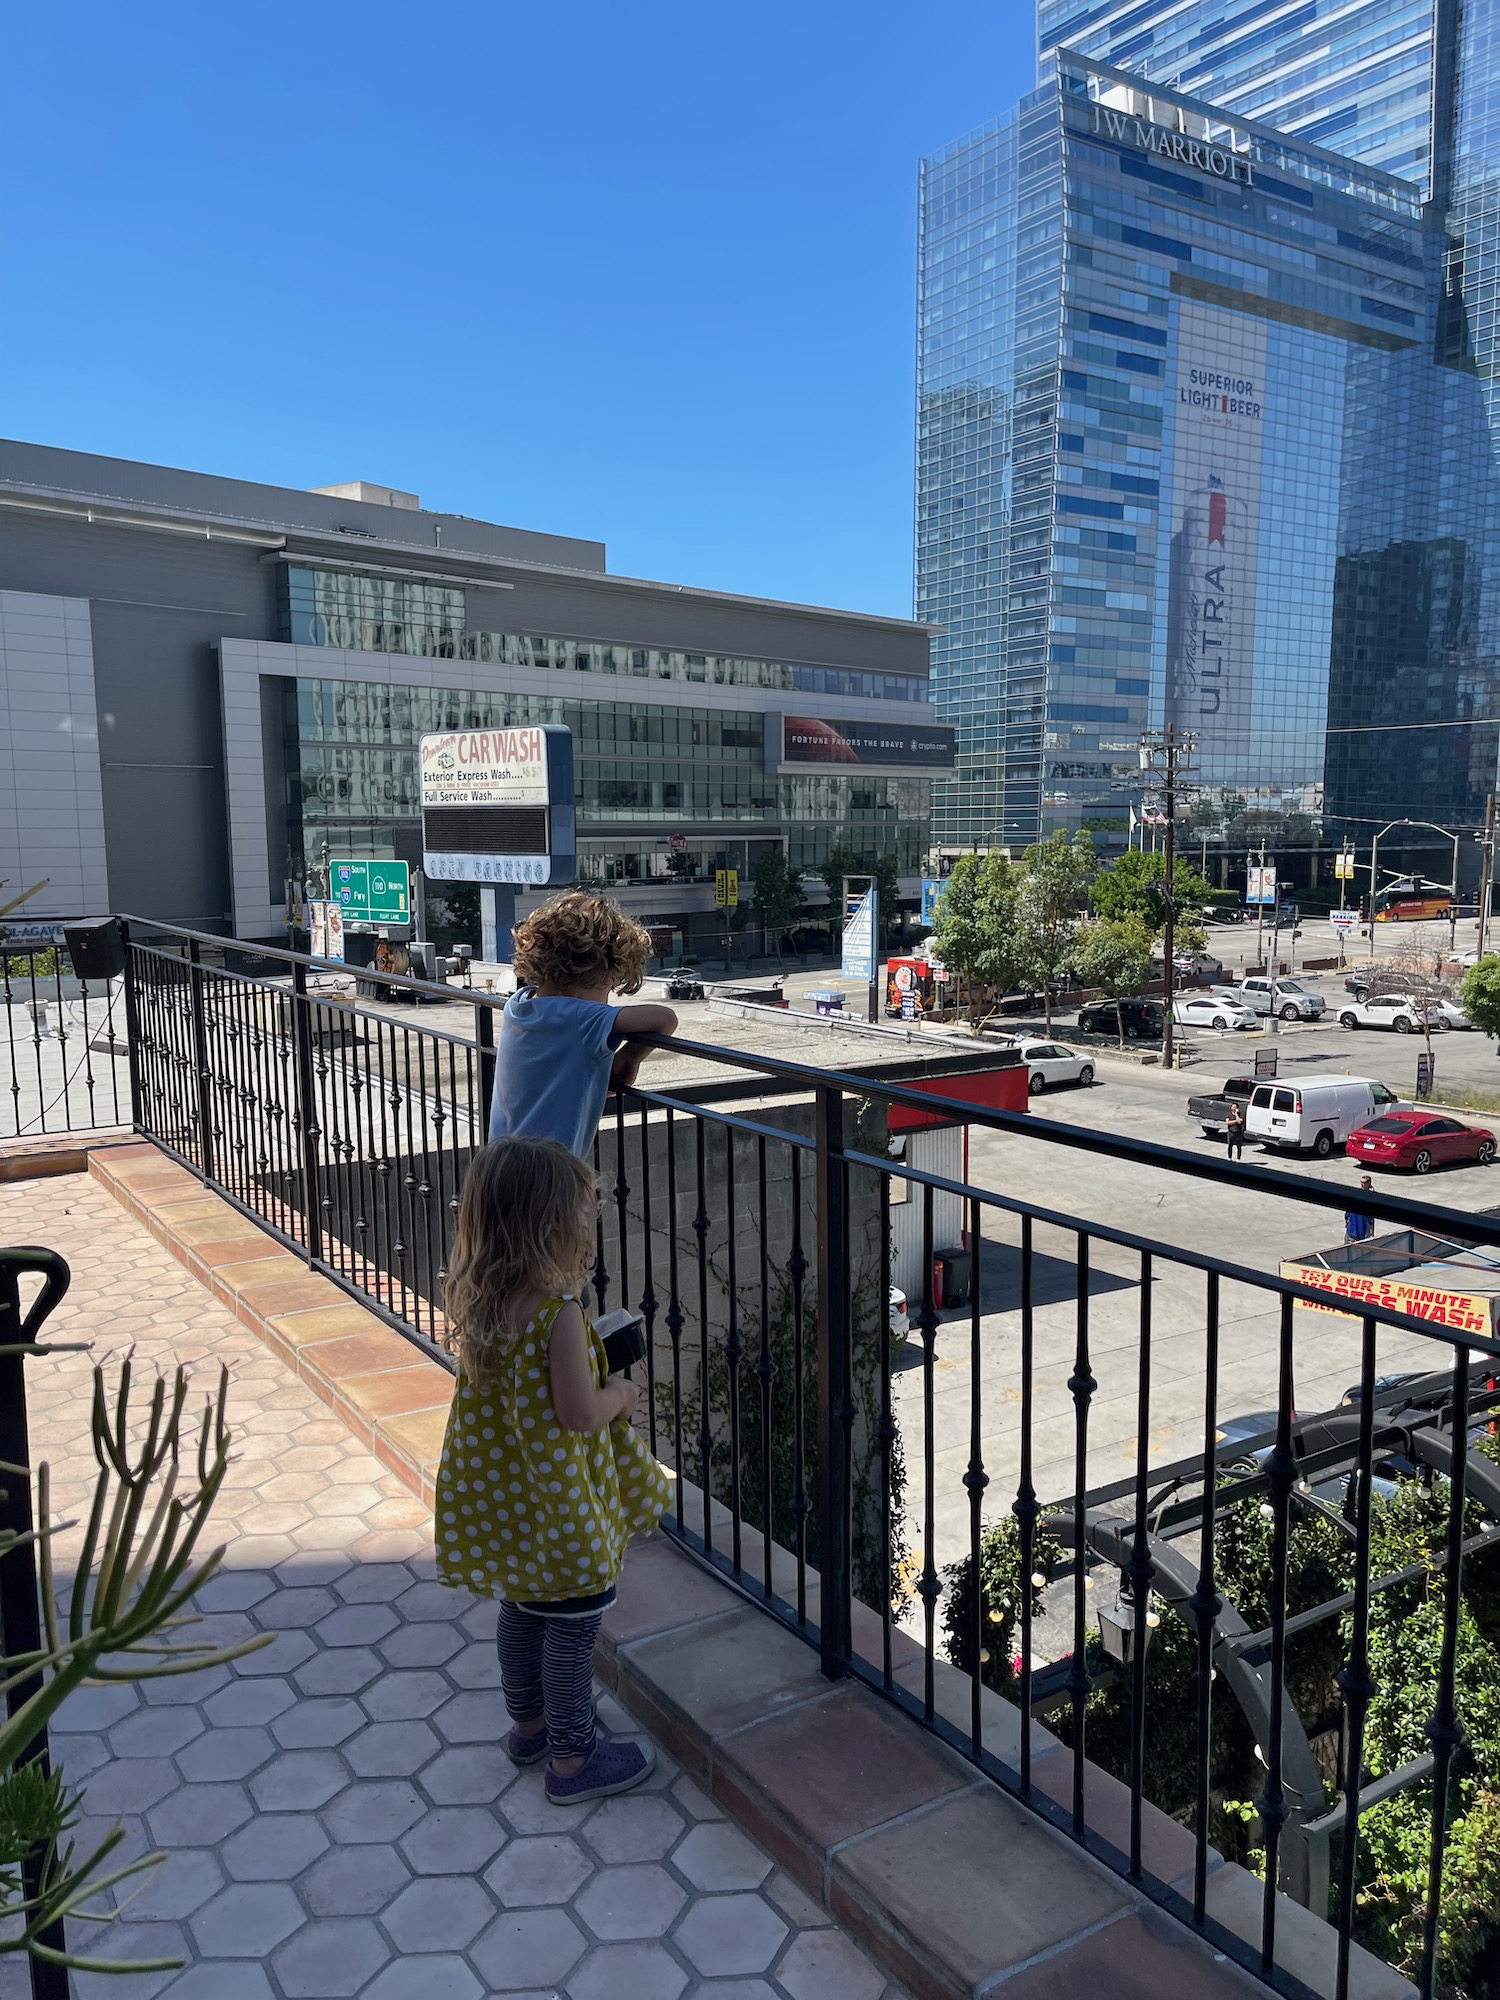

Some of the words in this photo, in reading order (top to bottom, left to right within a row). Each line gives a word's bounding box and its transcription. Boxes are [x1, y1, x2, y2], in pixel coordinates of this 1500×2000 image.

[1092, 106, 1128, 140] JW
[1134, 120, 1256, 187] MARRIOTT
[1190, 369, 1253, 396] SUPERIOR
[1180, 387, 1219, 409] LIGHT
[1230, 398, 1260, 418] BEER
[1200, 564, 1226, 714] ULTRA
[457, 734, 491, 764] CAR
[492, 730, 541, 763] WASH
[791, 735, 829, 745] FORTUNE
[831, 738, 861, 747] FAVORS
[864, 739, 878, 748] THE
[880, 740, 904, 749] BRAVE
[423, 770, 454, 782] Exterior
[457, 770, 488, 782] Express
[424, 791, 438, 802] Full
[440, 790, 468, 802] Service
[343, 892, 348, 900] 10
[354, 891, 365, 903] Fwy
[374, 881, 383, 891] 110
[1301, 1269, 1332, 1284] TRY
[1337, 1275, 1373, 1292] OUR
[1380, 1283, 1391, 1295] 5
[1397, 1286, 1472, 1310] MINUTE
[1406, 1301, 1485, 1331] WASH
